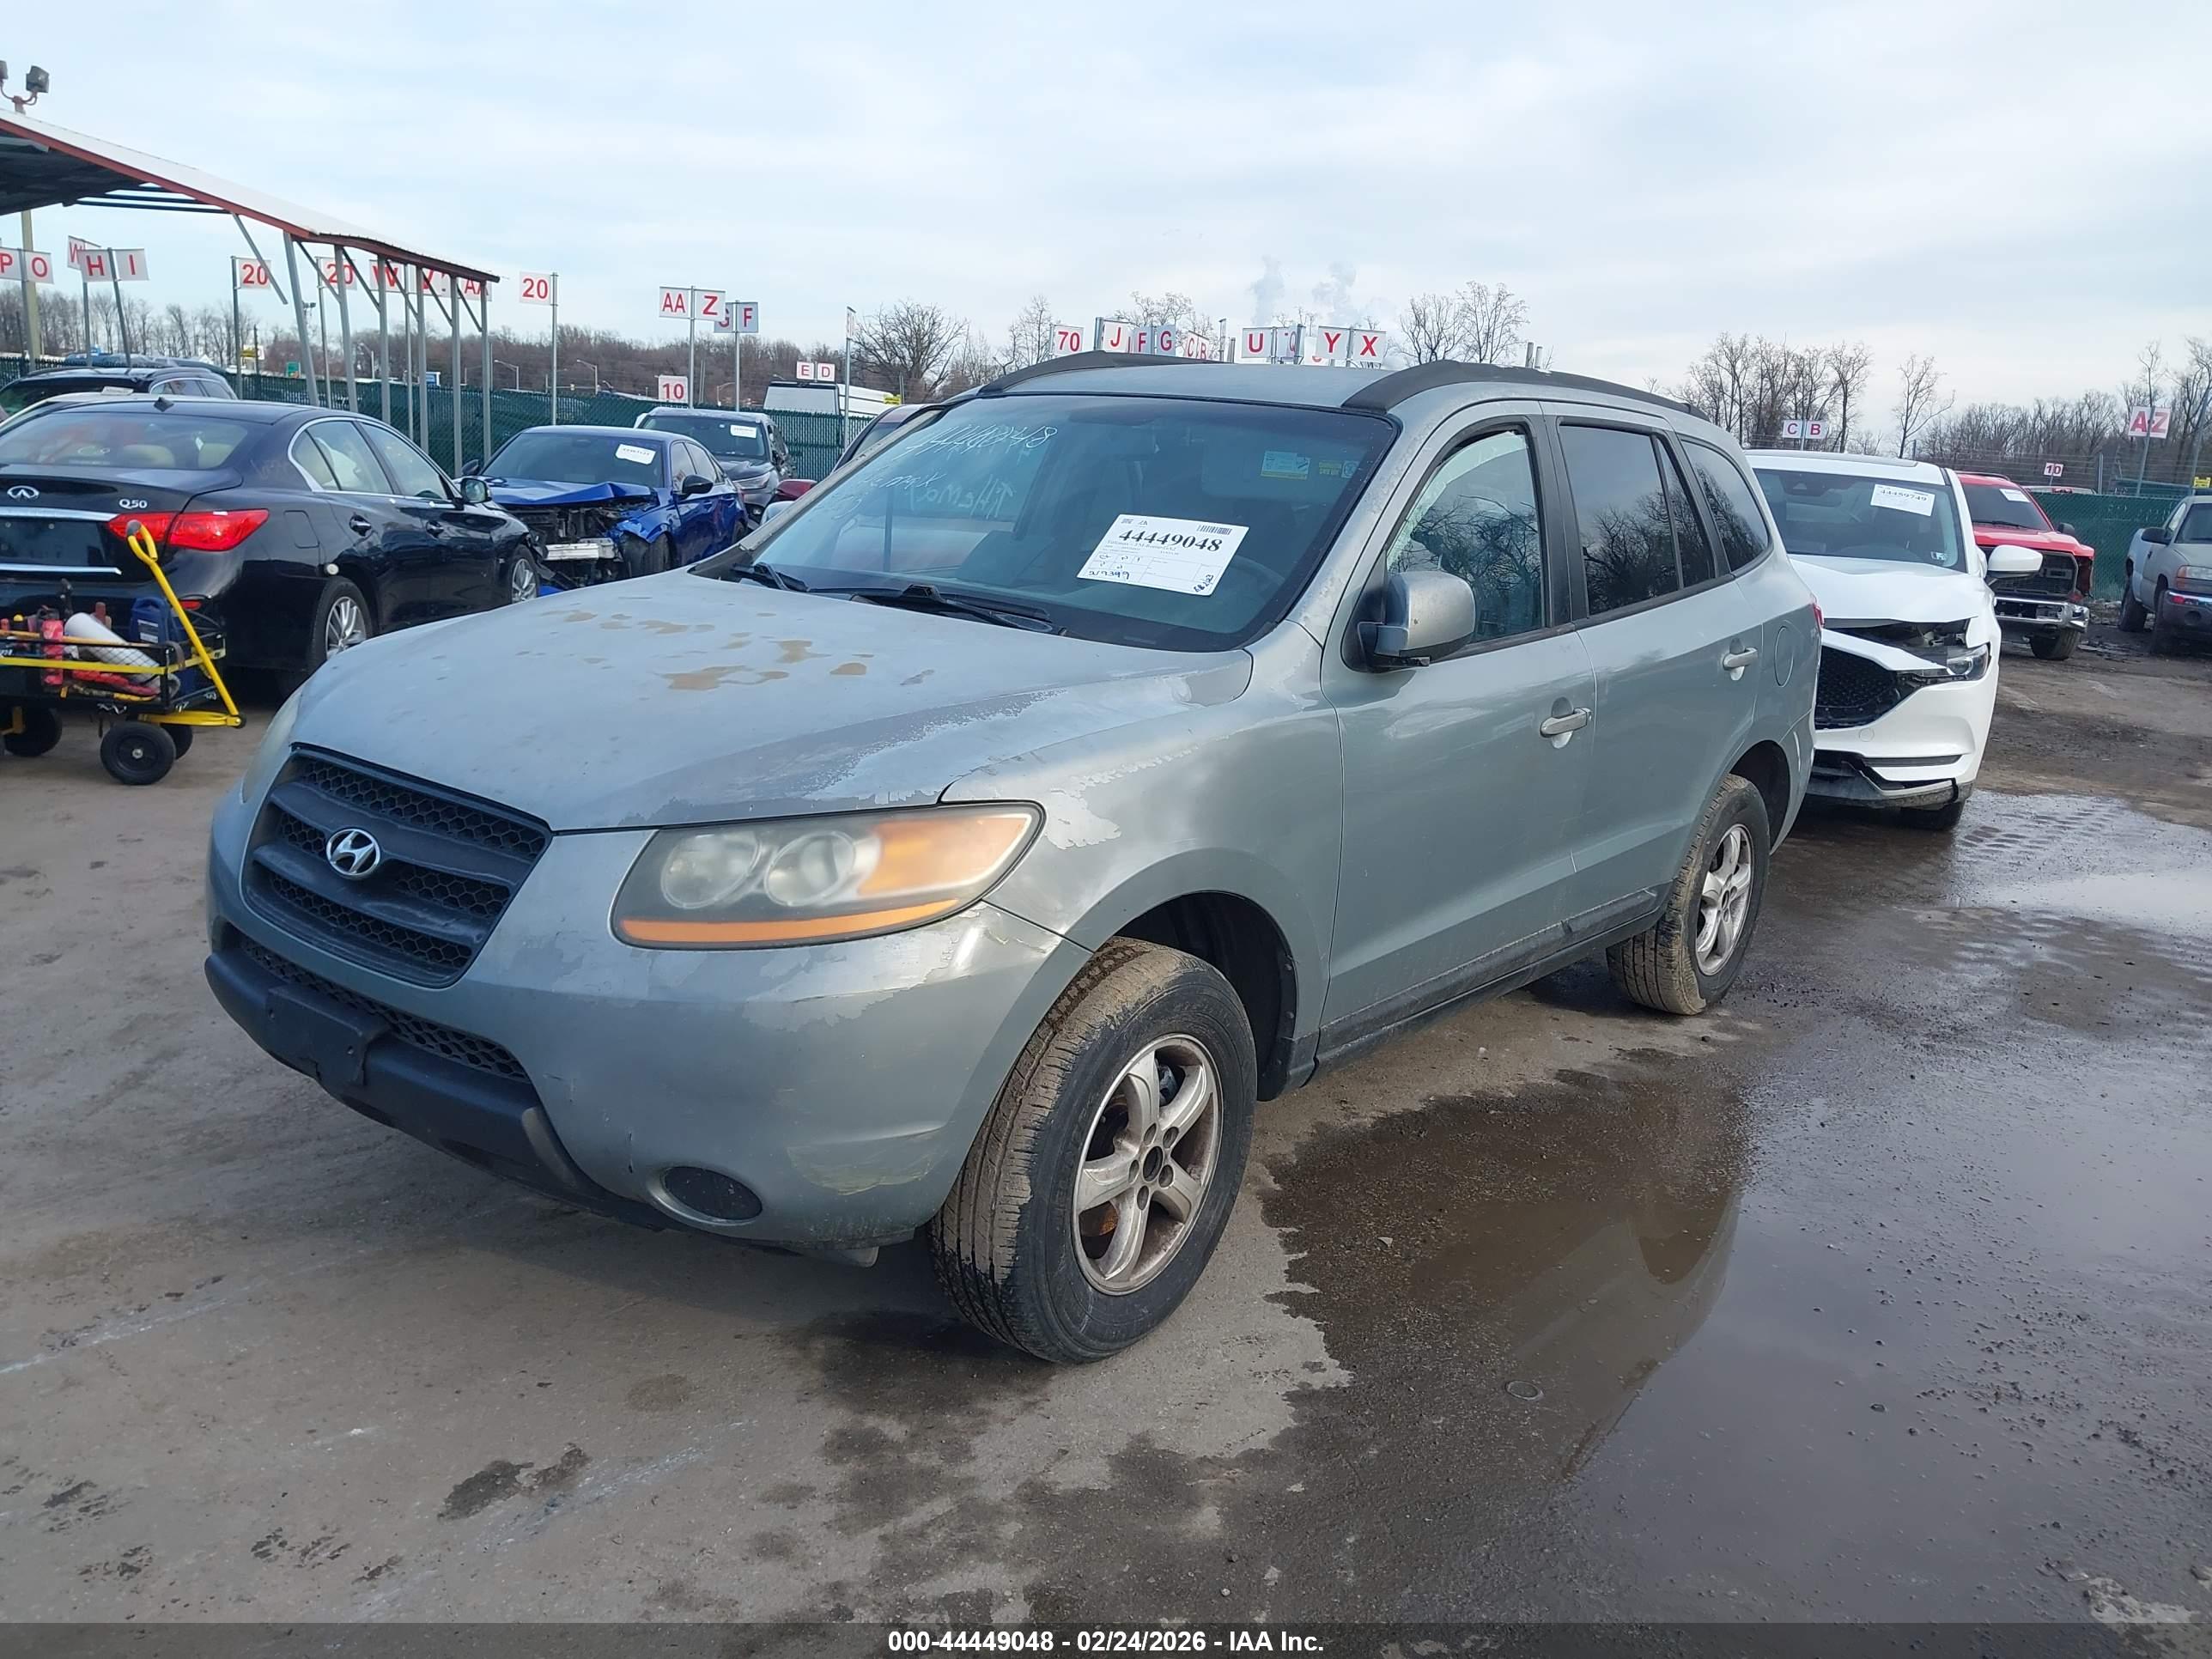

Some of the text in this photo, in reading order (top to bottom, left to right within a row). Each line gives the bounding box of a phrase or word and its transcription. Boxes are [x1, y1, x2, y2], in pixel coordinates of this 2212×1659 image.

[0, 252, 13, 273] P
[86, 255, 104, 276] H
[129, 254, 136, 275] I
[242, 264, 269, 285] 20
[327, 264, 354, 284] 20
[522, 278, 549, 299] 20
[662, 293, 686, 313] AA
[702, 295, 718, 315] Z
[744, 307, 753, 327] F
[1058, 331, 1080, 351] 70
[1110, 326, 1121, 347] J
[1139, 332, 1147, 352] F
[1160, 331, 1172, 351] G
[1187, 337, 1194, 356] C
[1249, 332, 1264, 353] U
[1325, 332, 1341, 353] Y
[1360, 335, 1378, 356] X
[801, 365, 810, 376] E
[821, 367, 830, 378] D
[662, 383, 684, 400] 10
[1787, 422, 1798, 435] C
[1810, 423, 1821, 435] B
[2045, 465, 2062, 475] 10
[118, 499, 148, 509] Q50
[1119, 529, 1223, 552] 44449048
